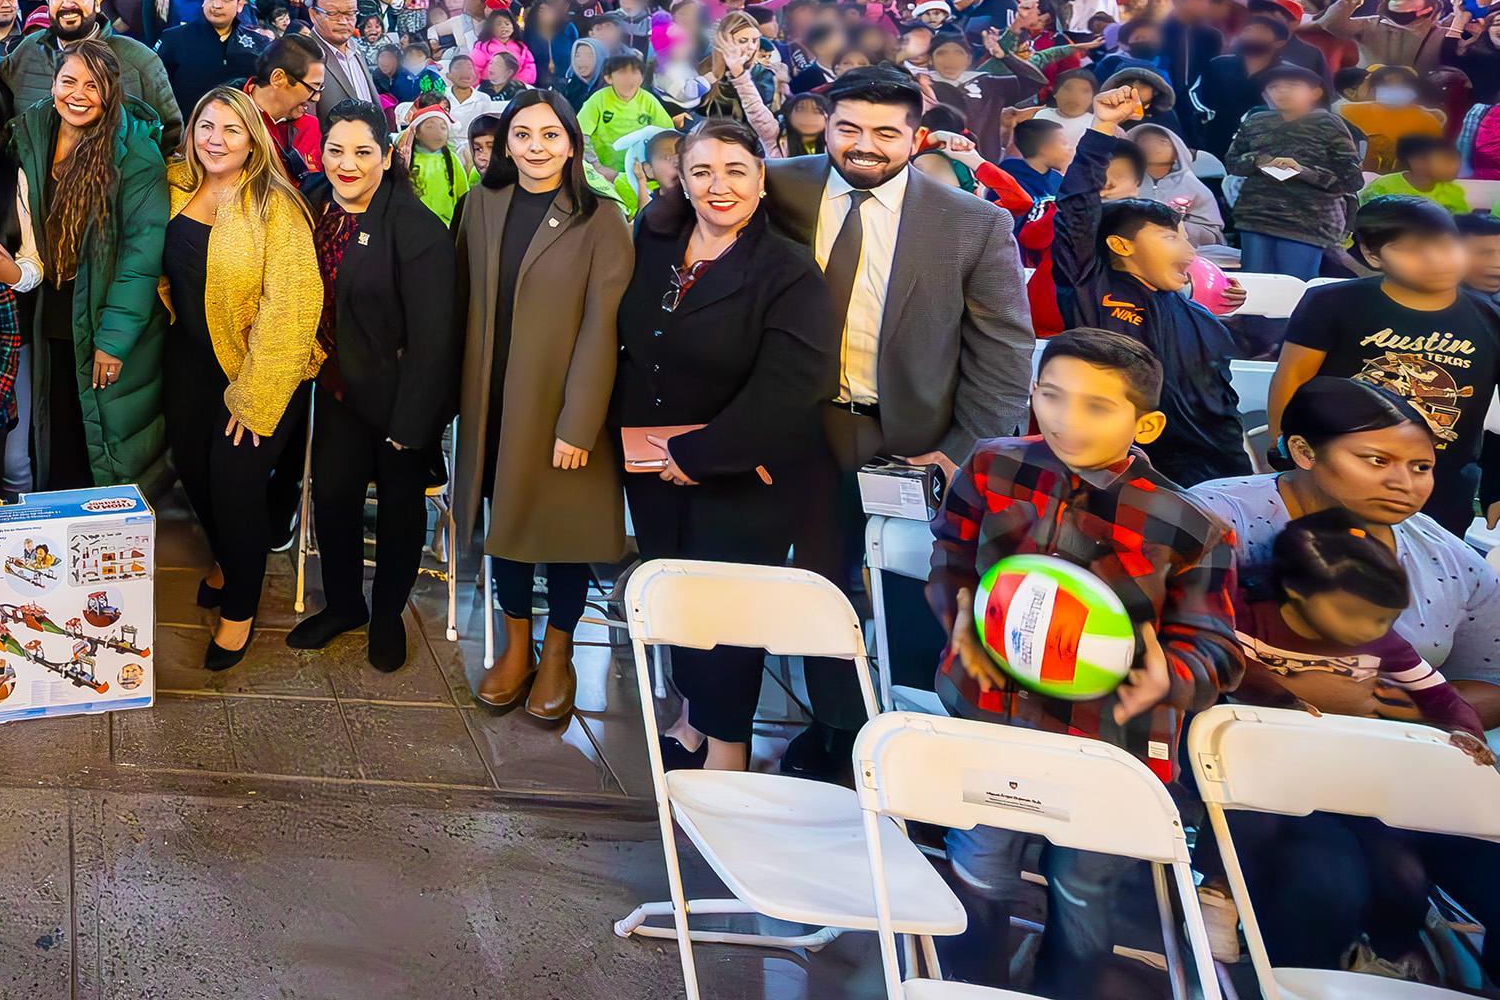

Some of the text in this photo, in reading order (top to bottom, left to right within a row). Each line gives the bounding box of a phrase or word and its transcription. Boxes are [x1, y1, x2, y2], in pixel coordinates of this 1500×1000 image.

[1111, 308, 1143, 326] NIKE
[1360, 328, 1476, 354] Austin
[1428, 352, 1472, 369] TEXAS
